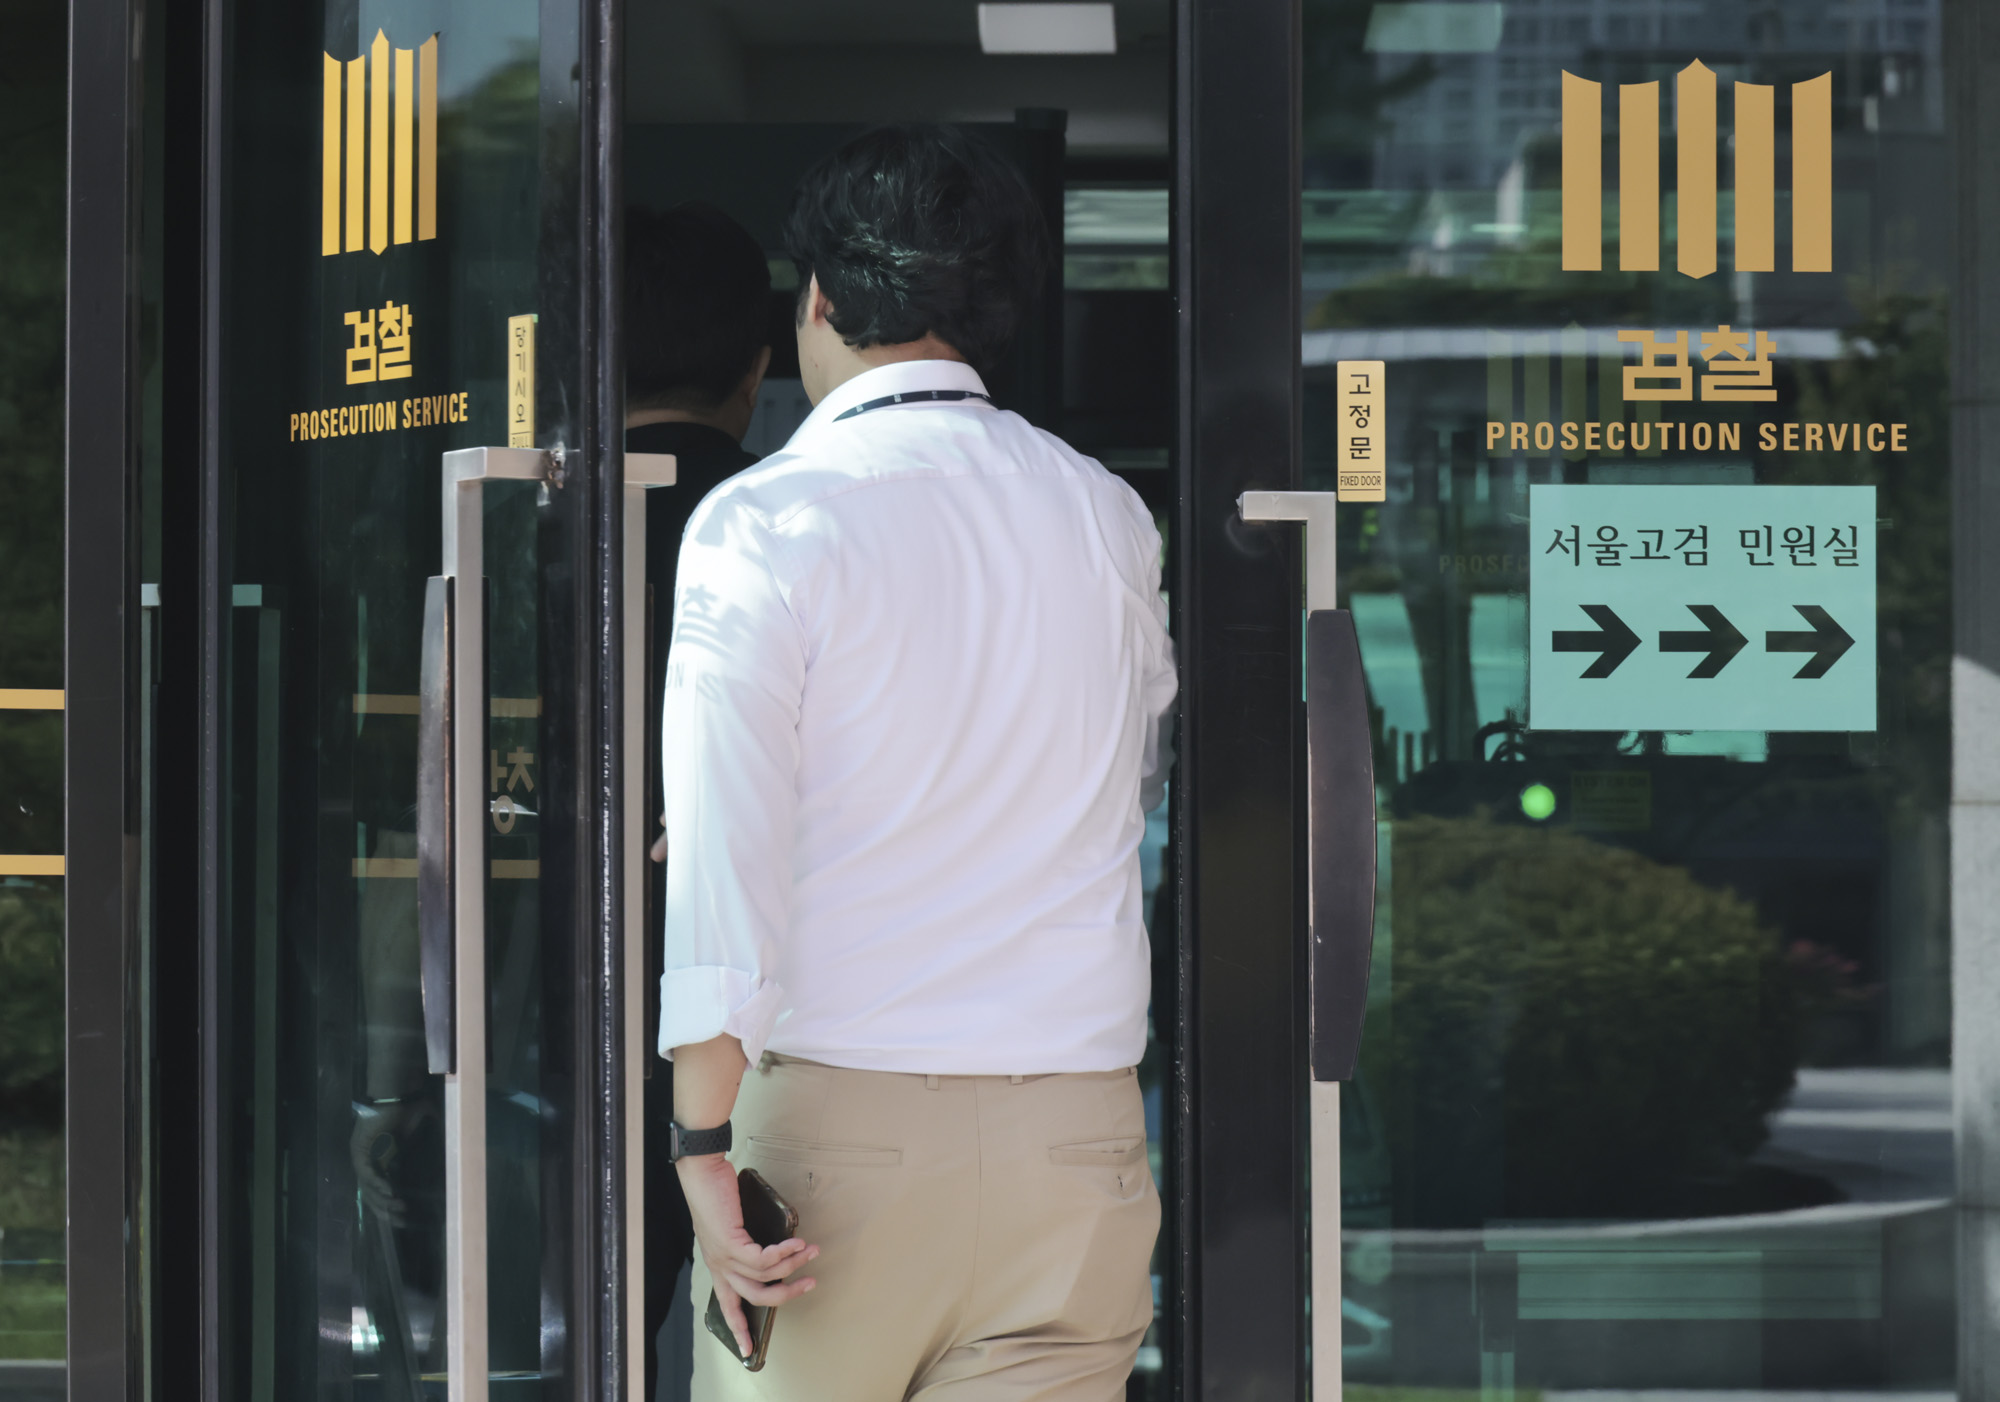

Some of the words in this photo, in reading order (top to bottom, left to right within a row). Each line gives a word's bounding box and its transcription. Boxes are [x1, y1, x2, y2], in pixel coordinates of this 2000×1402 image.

[344, 300, 413, 385] 검찰
[515, 326, 526, 423] 당기시오
[1617, 324, 1778, 402] 검찰
[290, 401, 397, 442] PROSECUTION
[402, 392, 468, 429] SERVICE
[1349, 374, 1371, 460] 고정문
[1486, 422, 1741, 452] PROSECUTION
[1758, 422, 1909, 452] SERVICE
[1340, 476, 1359, 486] FIXED
[1361, 476, 1381, 486] DOOR
[1545, 524, 1709, 568] 서울고검
[1739, 524, 1861, 568] 민원실
